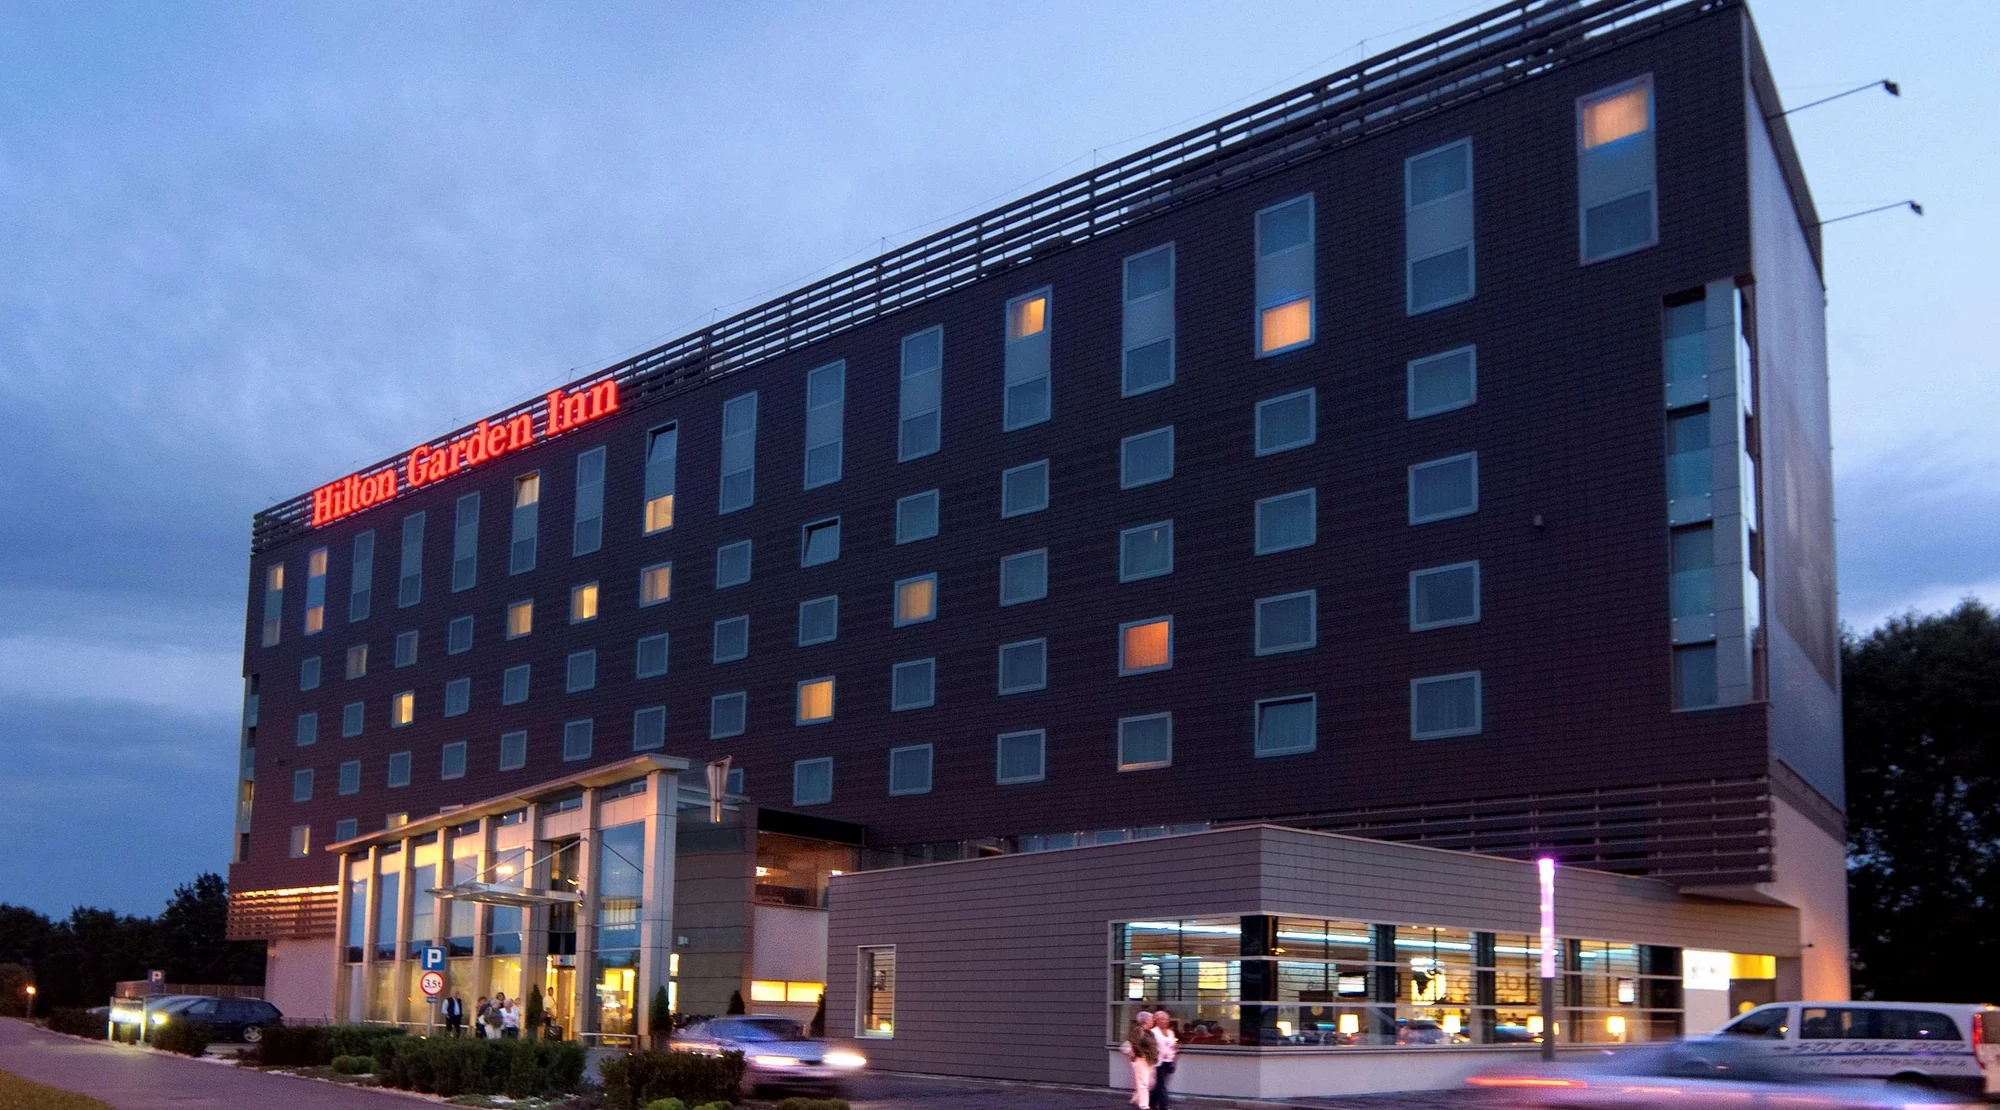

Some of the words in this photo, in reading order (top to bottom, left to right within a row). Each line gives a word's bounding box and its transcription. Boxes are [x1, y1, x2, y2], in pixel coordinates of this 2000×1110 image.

[312, 467, 397, 526] Hilton
[407, 412, 534, 487] Garden
[545, 379, 619, 437] Inn
[427, 949, 442, 968] P
[152, 970, 162, 982] P
